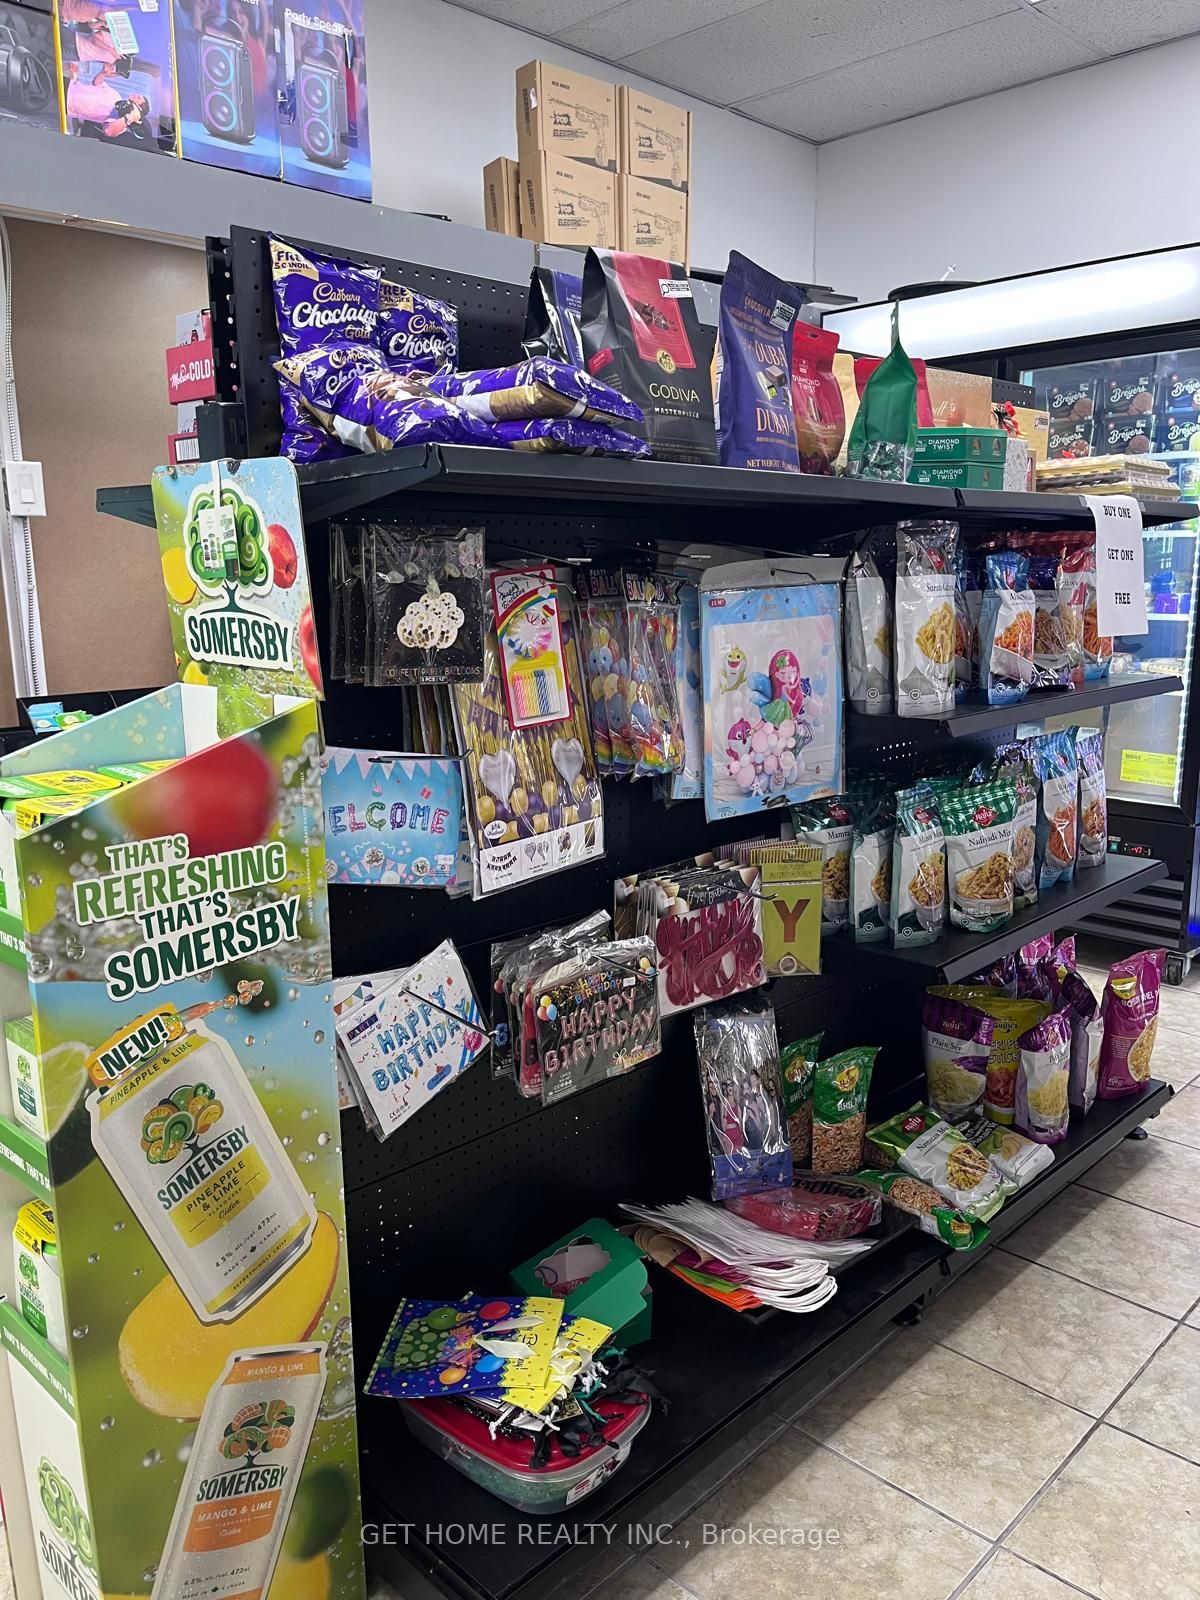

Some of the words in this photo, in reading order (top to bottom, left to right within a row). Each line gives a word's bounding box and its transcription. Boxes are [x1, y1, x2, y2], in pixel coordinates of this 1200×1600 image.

[285, 7, 312, 27] Party
[313, 14, 354, 36] Speaker
[313, 283, 360, 305] Cadbury
[292, 302, 378, 328] Choclairs
[189, 359, 211, 382] COLD
[649, 382, 700, 402] GODIVA
[1053, 391, 1088, 408] Breyers
[1111, 387, 1147, 402] Breyers
[654, 407, 700, 419] MASTERPIECE
[1049, 432, 1083, 448] Breyers
[1108, 428, 1144, 443] Breyers
[1103, 505, 1116, 517] BUY
[1117, 507, 1131, 519] ONE
[1107, 548, 1119, 560] GET
[1120, 550, 1134, 561] ONE
[1114, 592, 1131, 605] FREE
[188, 615, 289, 662] SOMERSBY
[329, 801, 450, 836] ELCOME
[108, 836, 187, 870] THAT'S
[969, 833, 997, 846] Nadiyadi
[76, 844, 285, 922] REFRESHING
[139, 891, 228, 939] THAT'S
[772, 899, 811, 943] Y
[107, 898, 297, 998] SOMERSBY
[377, 984, 446, 1055] HAPPY
[560, 988, 637, 1039] HAPPY
[100, 1016, 169, 1078] NEW!
[371, 997, 469, 1092] BIRTHDAY
[110, 1062, 161, 1105] PINEAPPLE
[162, 1055, 170, 1065] &
[171, 1040, 193, 1059] LIME
[837, 1100, 855, 1111] BHEL
[157, 1125, 251, 1210] SOMERSBY
[186, 1160, 247, 1213] PINEAPPLE
[202, 1202, 211, 1212] &
[212, 1176, 241, 1205] LIME
[218, 1198, 241, 1220] Cider
[223, 1262, 239, 1276] MADE
[259, 1224, 281, 1245] CANADA
[246, 1365, 278, 1377] MANGO
[287, 1363, 304, 1373] LIME
[196, 1465, 289, 1502] SOMERSBY
[198, 1508, 237, 1522] MANGO
[240, 1506, 248, 1514] &
[251, 1500, 273, 1512] LIME
[40, 1530, 98, 1600] SOMER
